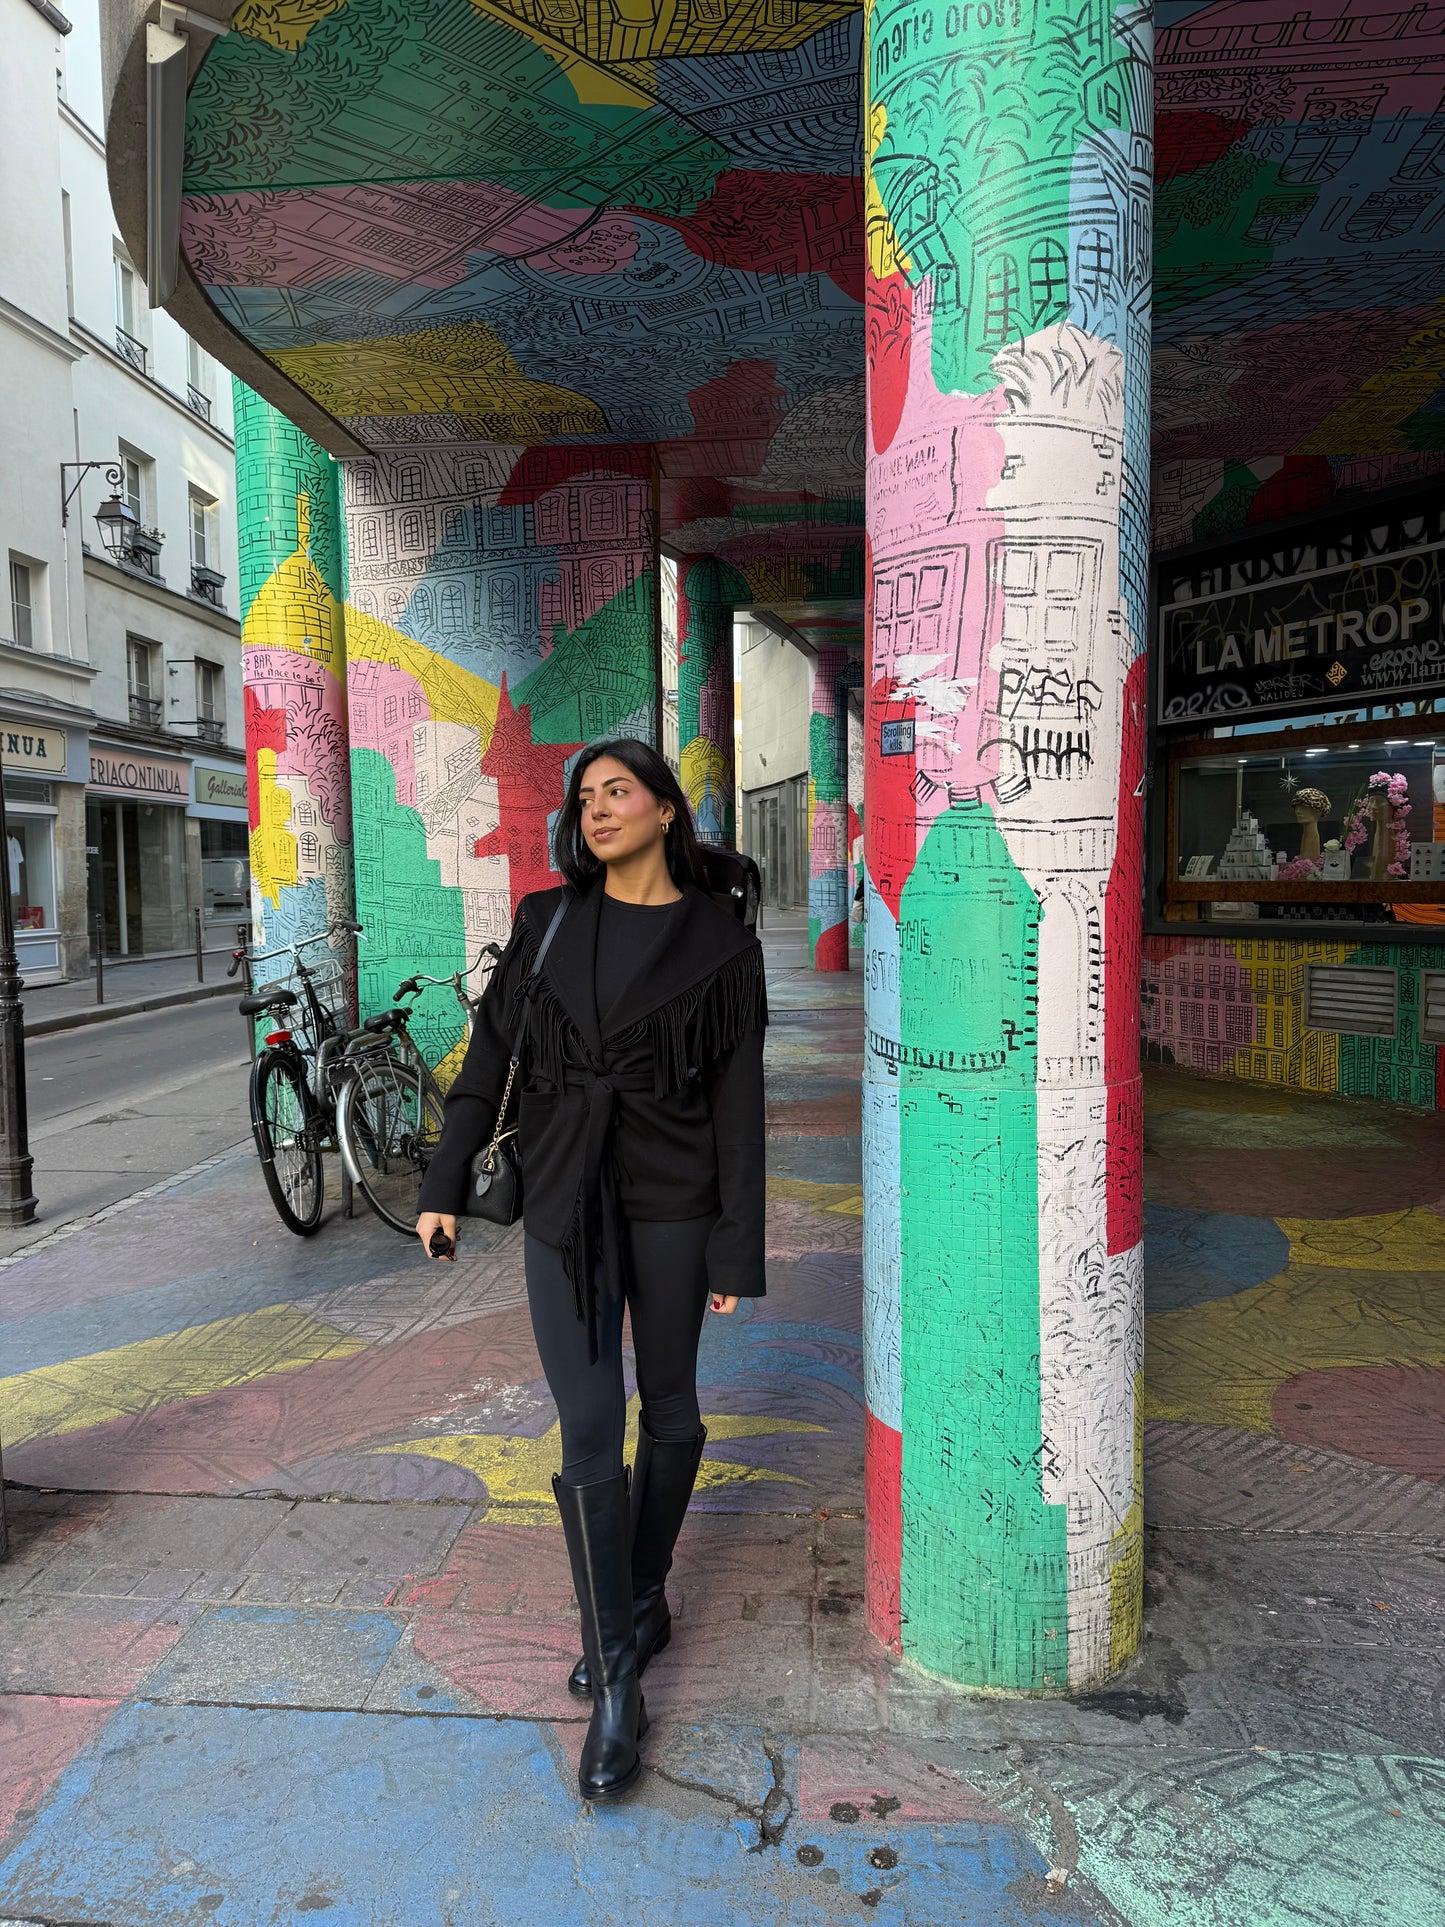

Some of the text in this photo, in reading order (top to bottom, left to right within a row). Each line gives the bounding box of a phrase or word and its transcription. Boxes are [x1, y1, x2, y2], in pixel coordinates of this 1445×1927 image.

[1196, 634, 1244, 675] LA
[1254, 597, 1445, 665] METROP
[253, 654, 273, 670] BAR
[883, 724, 912, 739] Scrolling
[889, 739, 903, 751] kills
[89, 757, 182, 793] ERIACONTINUA
[895, 918, 932, 956] THE
